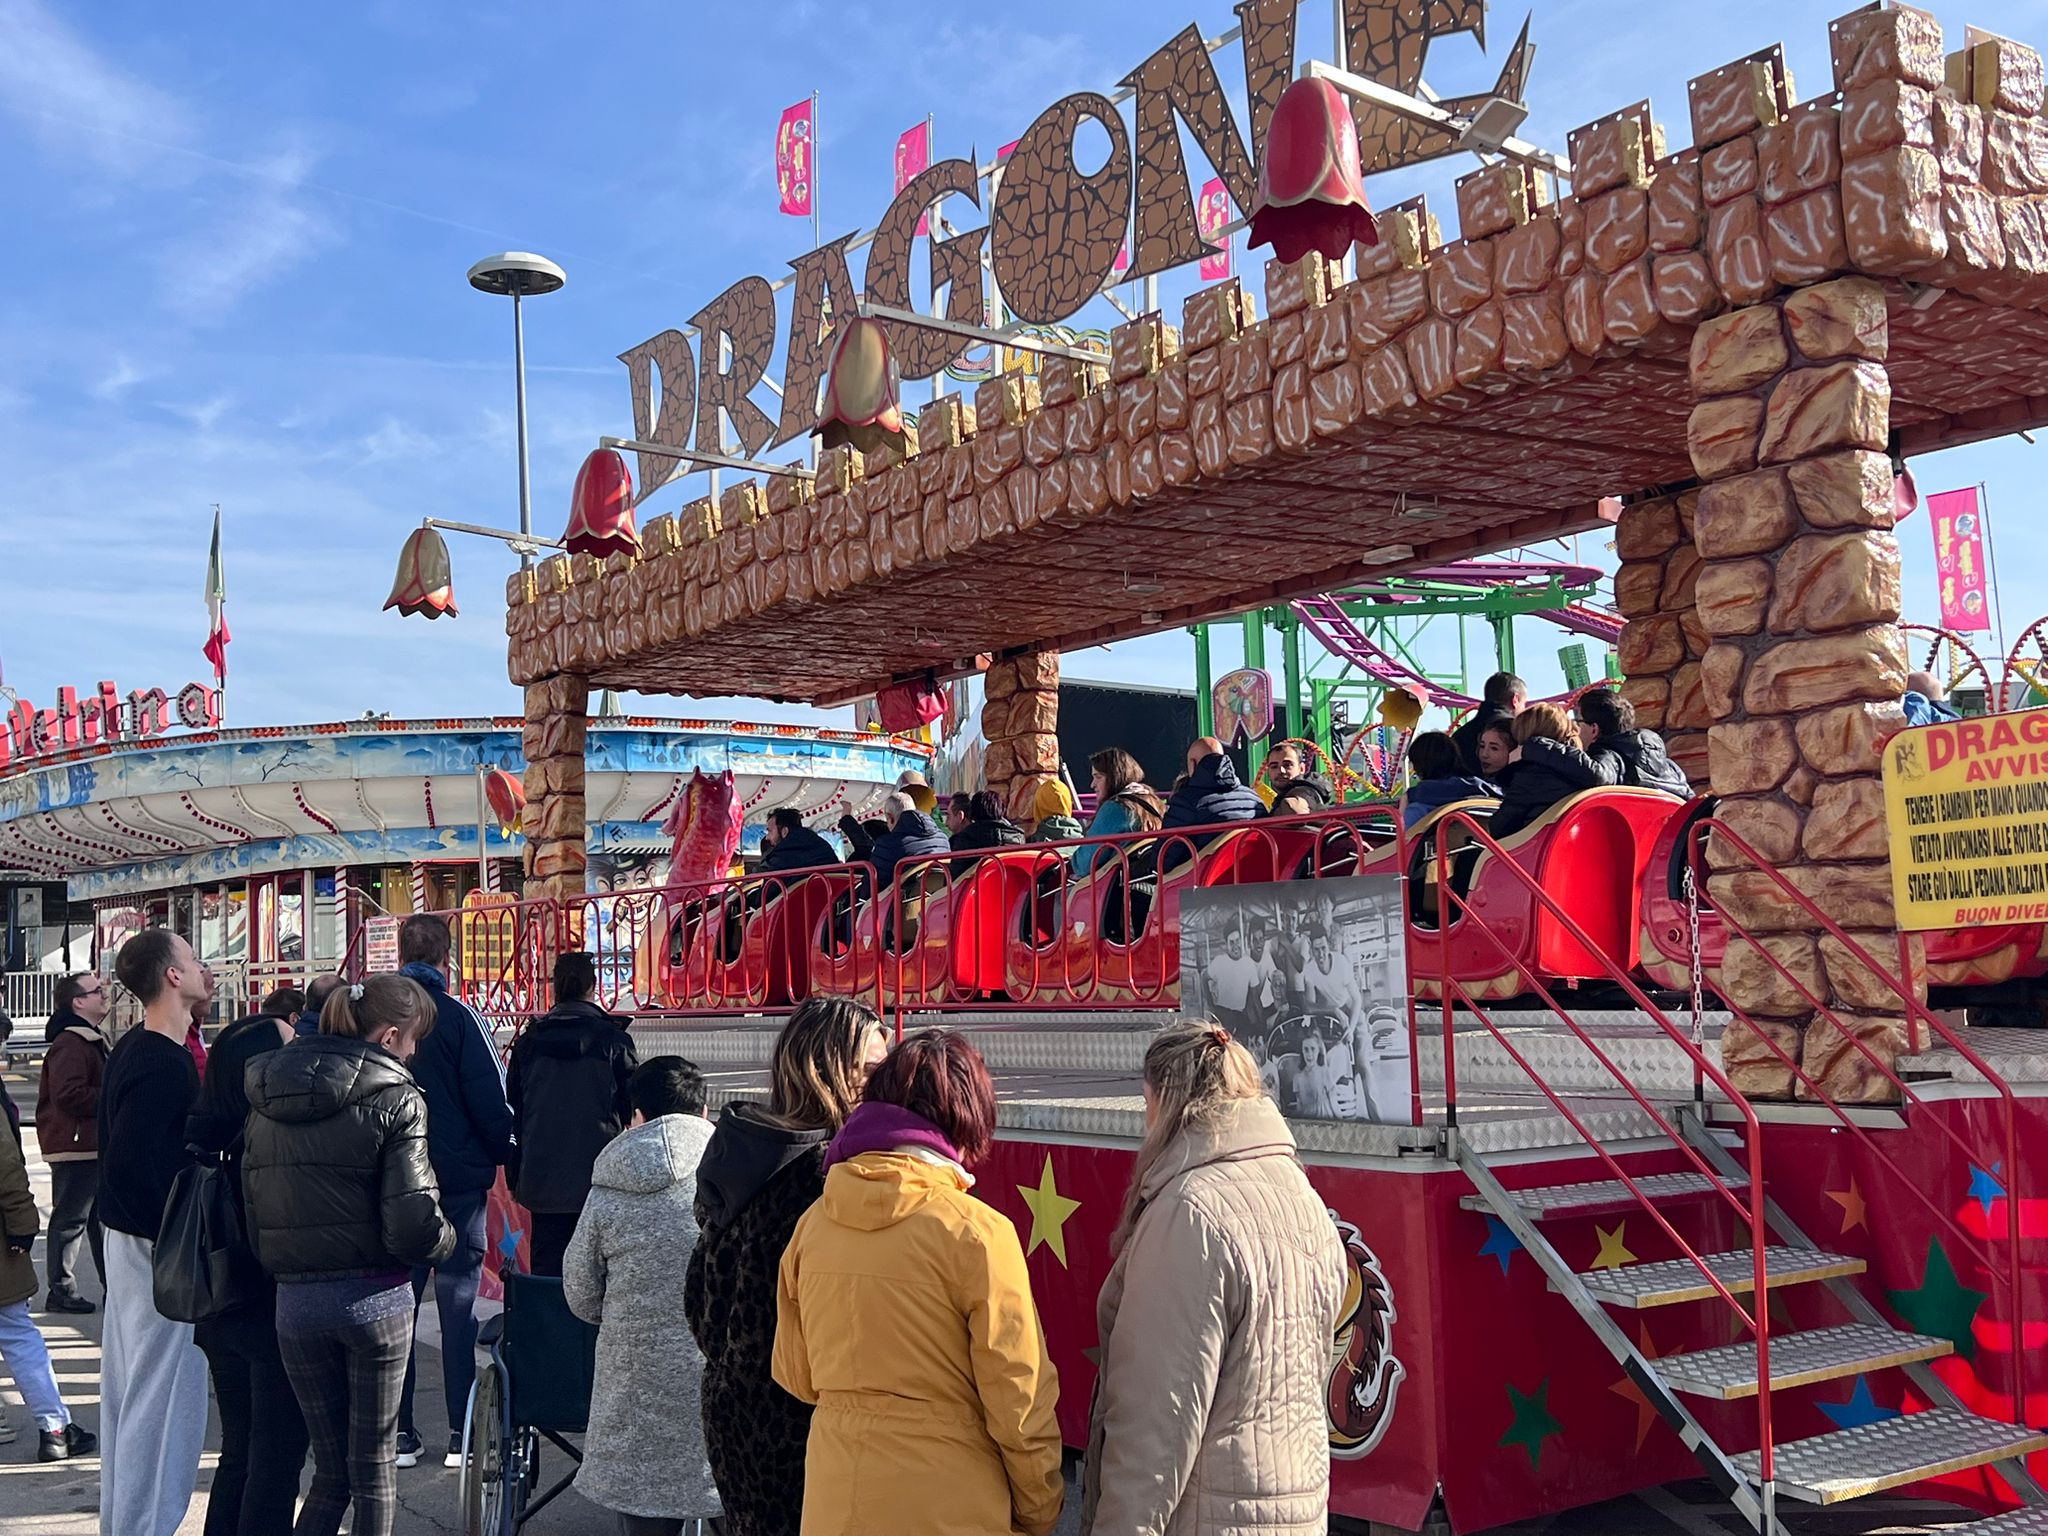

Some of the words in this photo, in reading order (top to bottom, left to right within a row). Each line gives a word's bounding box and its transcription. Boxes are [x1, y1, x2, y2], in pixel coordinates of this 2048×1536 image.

[616, 0, 1531, 502] DRAGONE
[1905, 795, 1935, 825] TENERE
[1935, 794, 1940, 822] I
[1940, 790, 1973, 822] BAMBINI
[1973, 788, 1990, 817] PER
[1990, 785, 2013, 816] MANO
[1910, 833, 1941, 863] VIETATO
[1943, 828, 1991, 860] AVVICINARSI
[1993, 826, 2012, 856] ALLE
[2013, 823, 2042, 854] ROTAIE
[1908, 873, 1933, 903] STARE
[1933, 866, 1947, 900] GIÙ
[1948, 869, 1974, 900] DALLA
[1974, 868, 2006, 897] PEDANA
[2006, 863, 2045, 895] RIALZATA
[1955, 906, 2001, 923] BUON
[2006, 903, 2048, 920] DIVE
